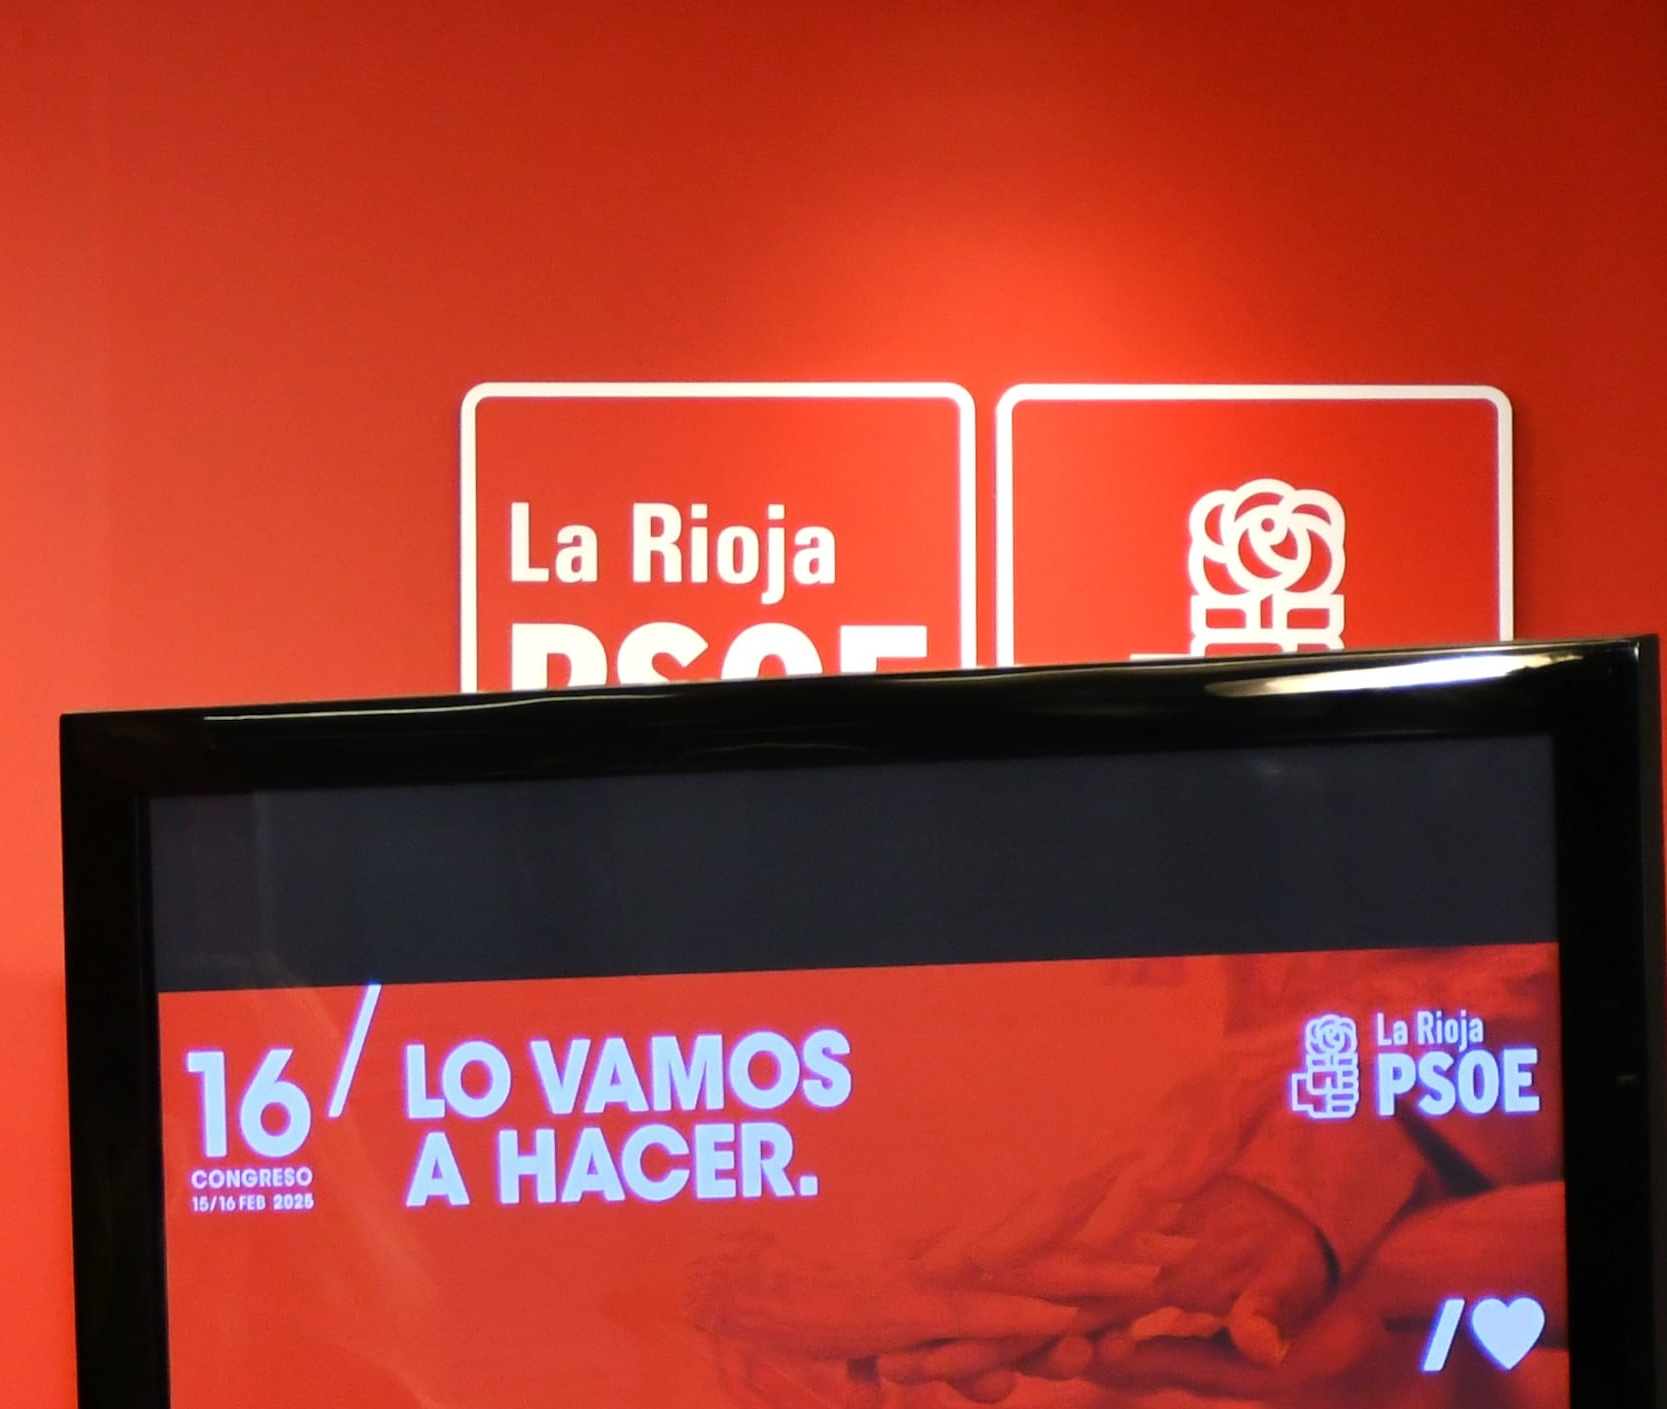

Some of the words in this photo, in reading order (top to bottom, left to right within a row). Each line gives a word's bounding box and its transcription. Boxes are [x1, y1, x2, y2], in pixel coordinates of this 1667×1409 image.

[510, 501, 598, 583] La
[633, 501, 836, 605] Rioja
[1375, 1012, 1409, 1046] La
[1417, 1009, 1485, 1052] Rioja
[187, 1050, 312, 1158] 16
[405, 1040, 512, 1120] LO
[530, 1028, 852, 1115] VAMOS
[1375, 1047, 1541, 1117] PSOE
[190, 1165, 314, 1190] CONGRESO
[238, 1194, 267, 1211] FEB
[272, 1192, 315, 1211] 2025
[405, 1132, 470, 1207] A
[498, 1122, 819, 1204] HACER.
